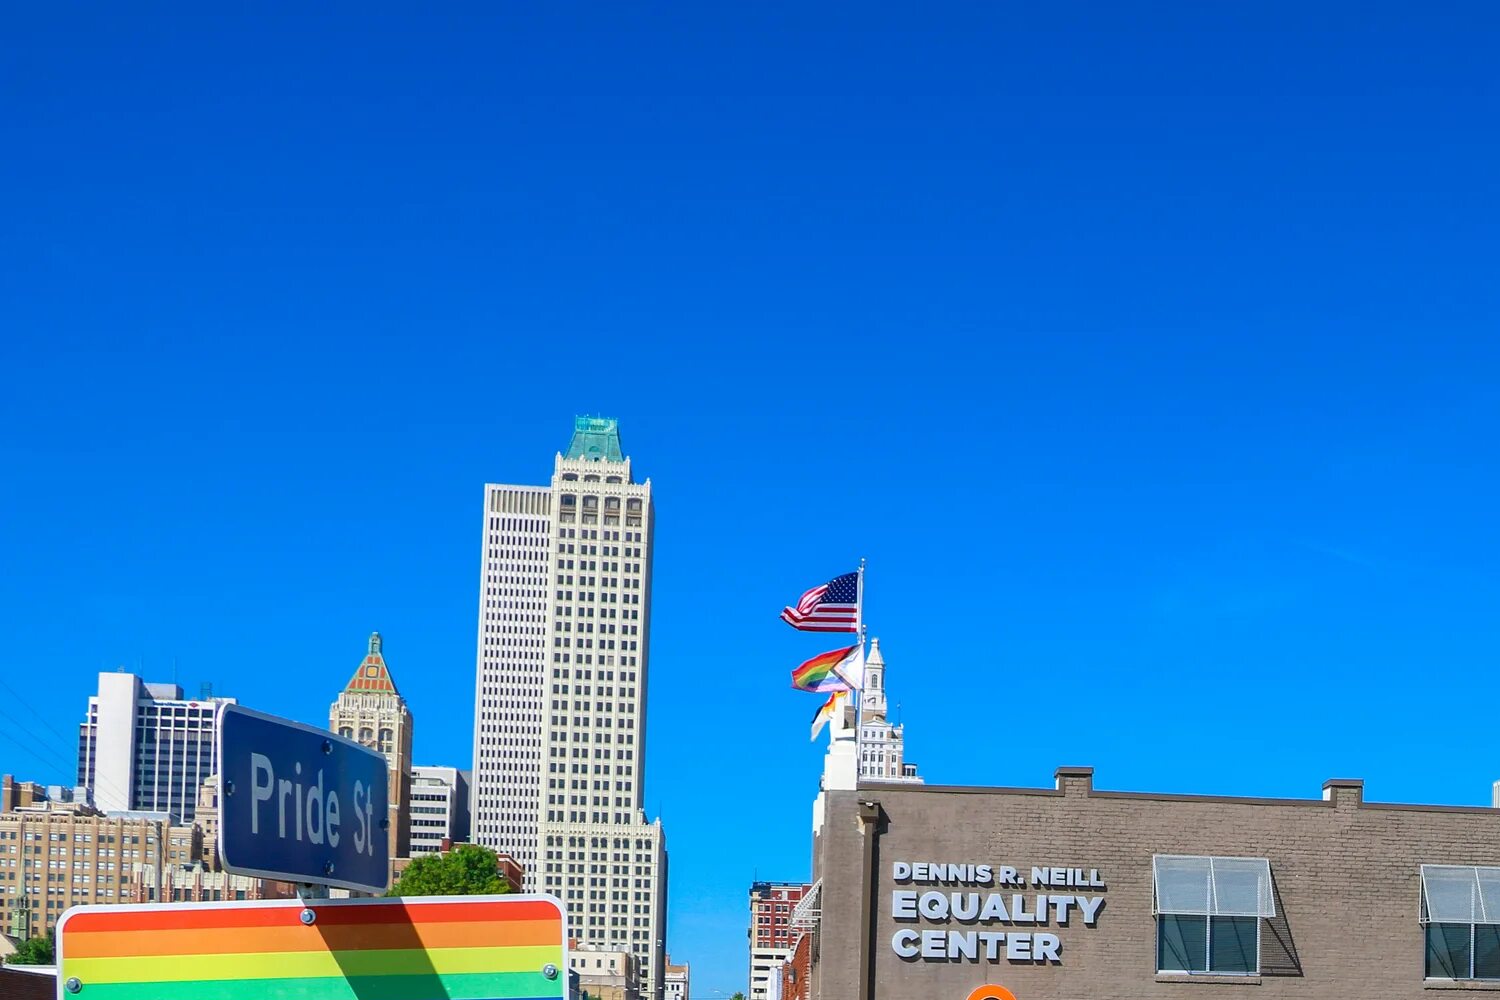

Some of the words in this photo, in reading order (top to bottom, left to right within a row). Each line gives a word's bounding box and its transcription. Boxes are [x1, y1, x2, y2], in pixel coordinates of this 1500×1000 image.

[252, 752, 340, 848] Pride
[353, 779, 373, 857] St
[892, 861, 993, 883] DENNIS
[999, 865, 1025, 885] R.
[1031, 866, 1105, 887] NEILL
[892, 889, 1104, 924] EQUALITY
[891, 928, 1060, 961] CENTER
